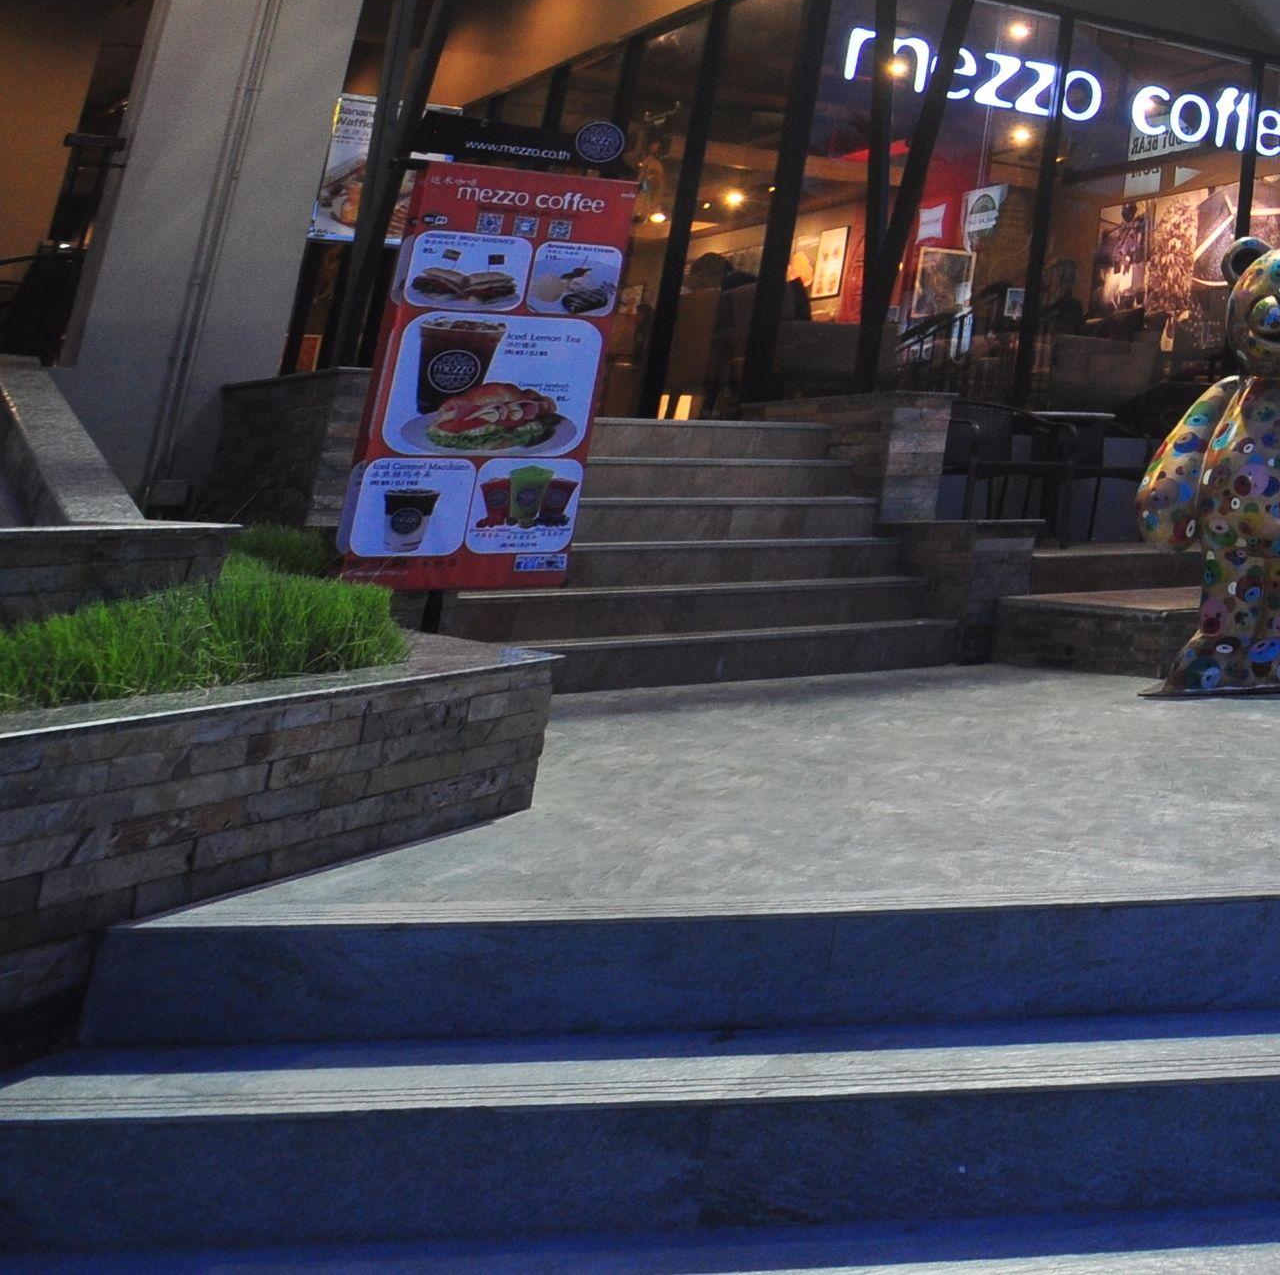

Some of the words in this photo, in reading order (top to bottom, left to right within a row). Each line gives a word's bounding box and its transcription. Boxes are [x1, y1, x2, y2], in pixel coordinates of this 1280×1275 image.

[842, 26, 1101, 122] mezzo
[465, 139, 571, 161] www.mezzo.co.th
[456, 186, 530, 206] mezzo
[535, 192, 605, 213] coffee
[506, 332, 528, 341] Iced
[530, 333, 562, 343] Lemon
[566, 334, 582, 344] Tea
